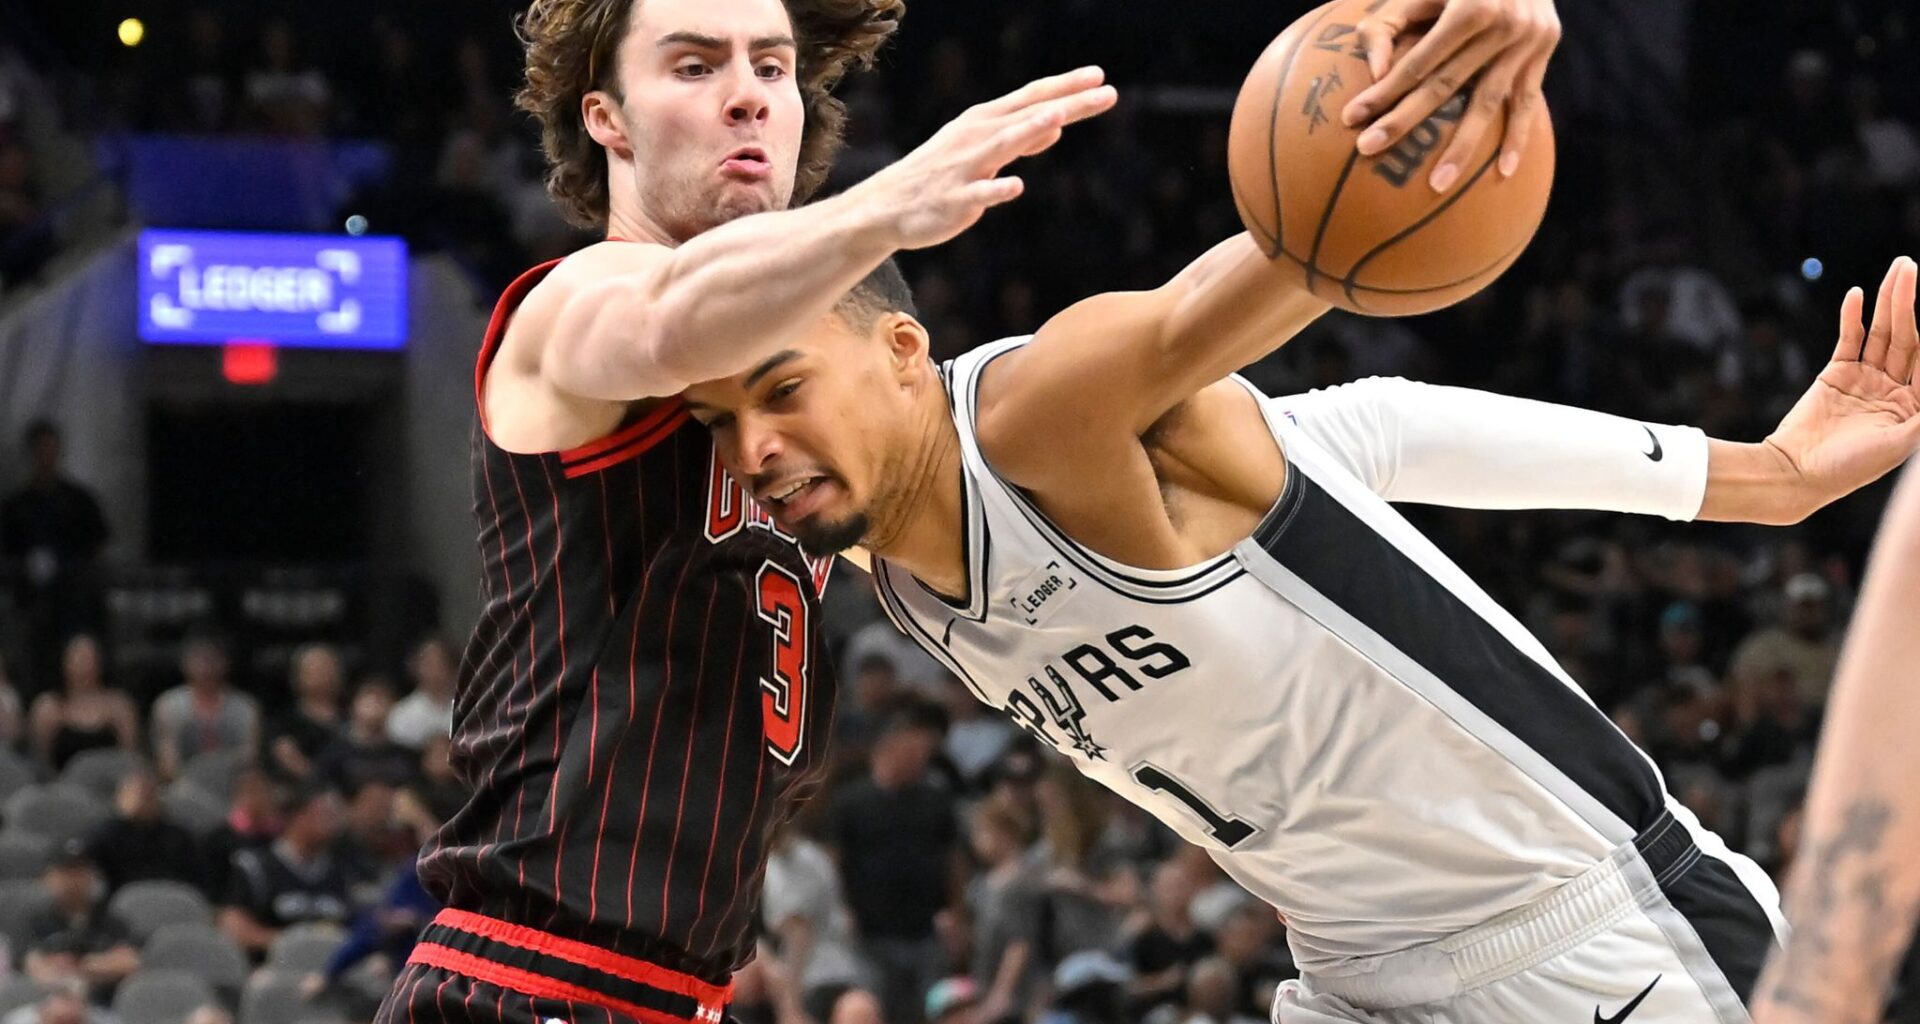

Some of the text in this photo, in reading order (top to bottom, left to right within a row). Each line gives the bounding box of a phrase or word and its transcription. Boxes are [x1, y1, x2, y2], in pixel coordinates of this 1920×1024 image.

[178, 264, 333, 313] LEDGER
[1021, 574, 1064, 614] LEDGER
[755, 558, 809, 766] 3
[1129, 760, 1263, 851] 1
